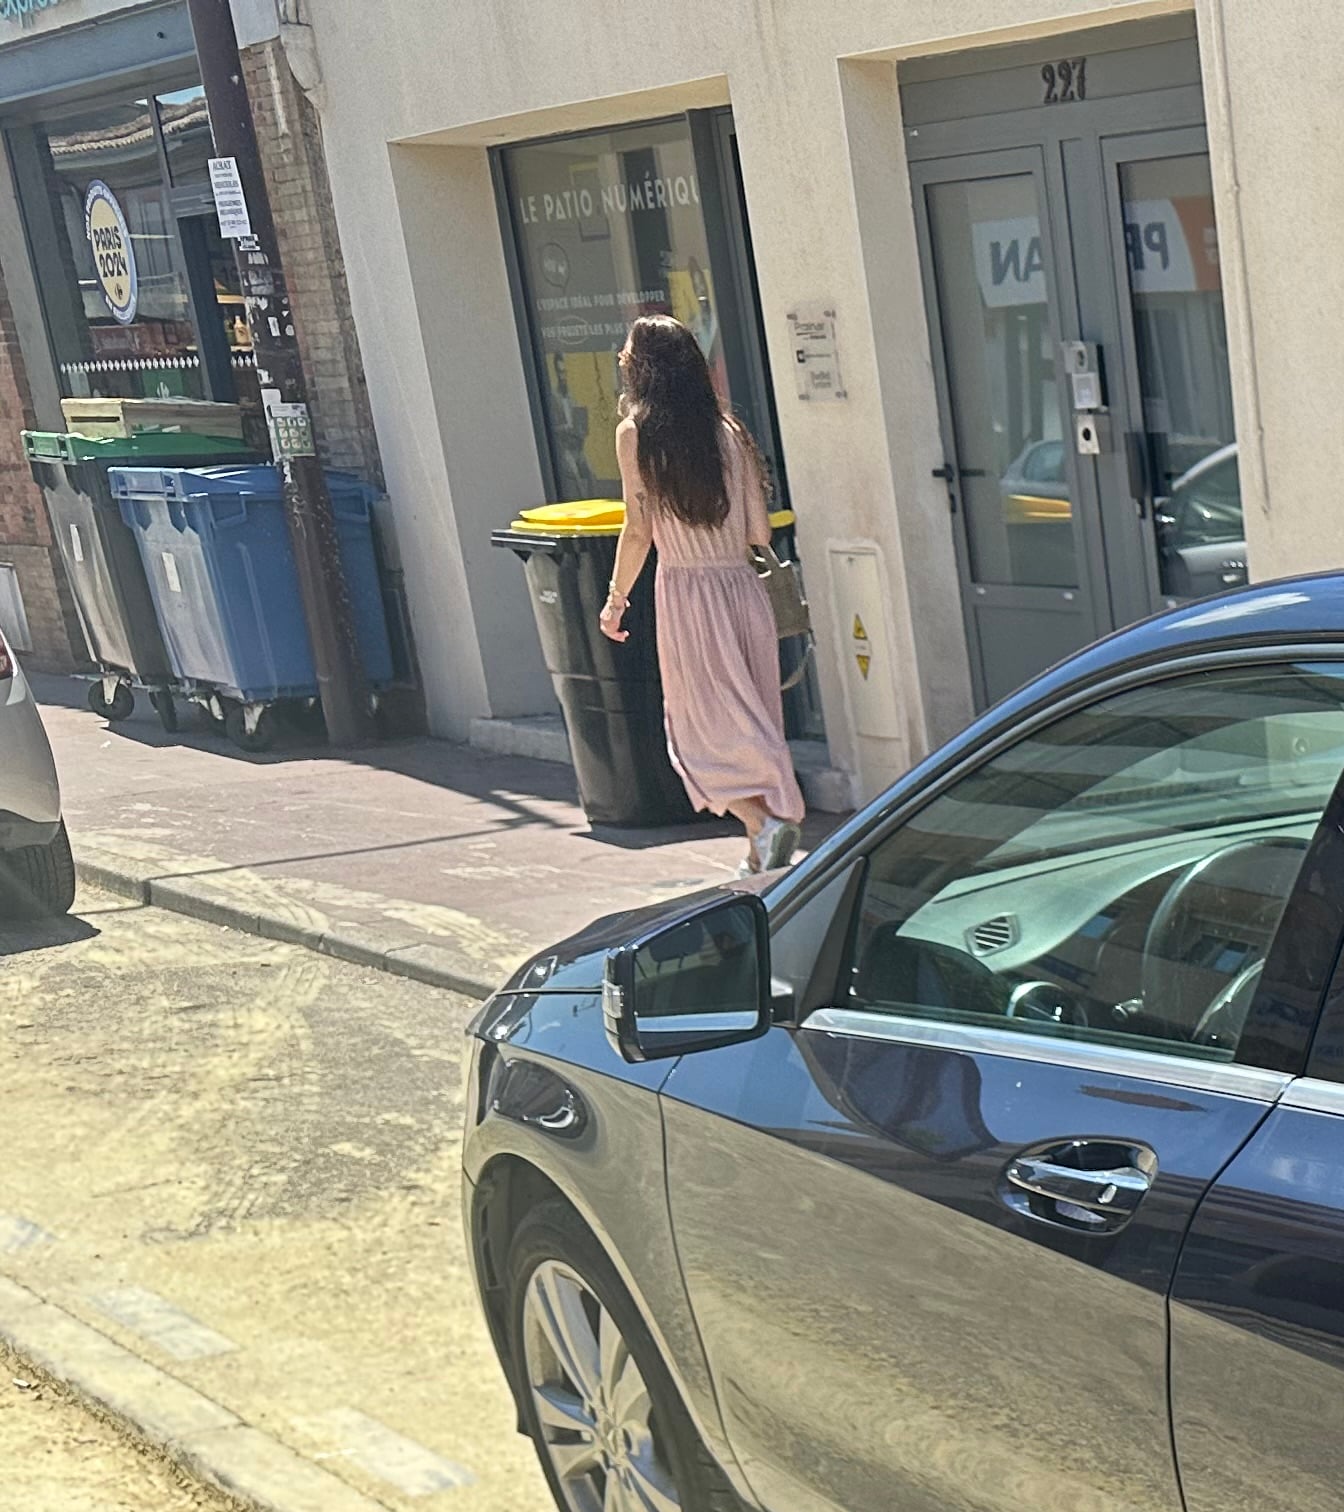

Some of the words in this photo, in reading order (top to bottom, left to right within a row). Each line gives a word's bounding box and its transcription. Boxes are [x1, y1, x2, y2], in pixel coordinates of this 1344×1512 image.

[1040, 57, 1087, 103] 227
[520, 194, 539, 224] LE
[543, 188, 593, 221] PATIO
[93, 226, 122, 251] PARIS
[99, 252, 129, 278] 2024
